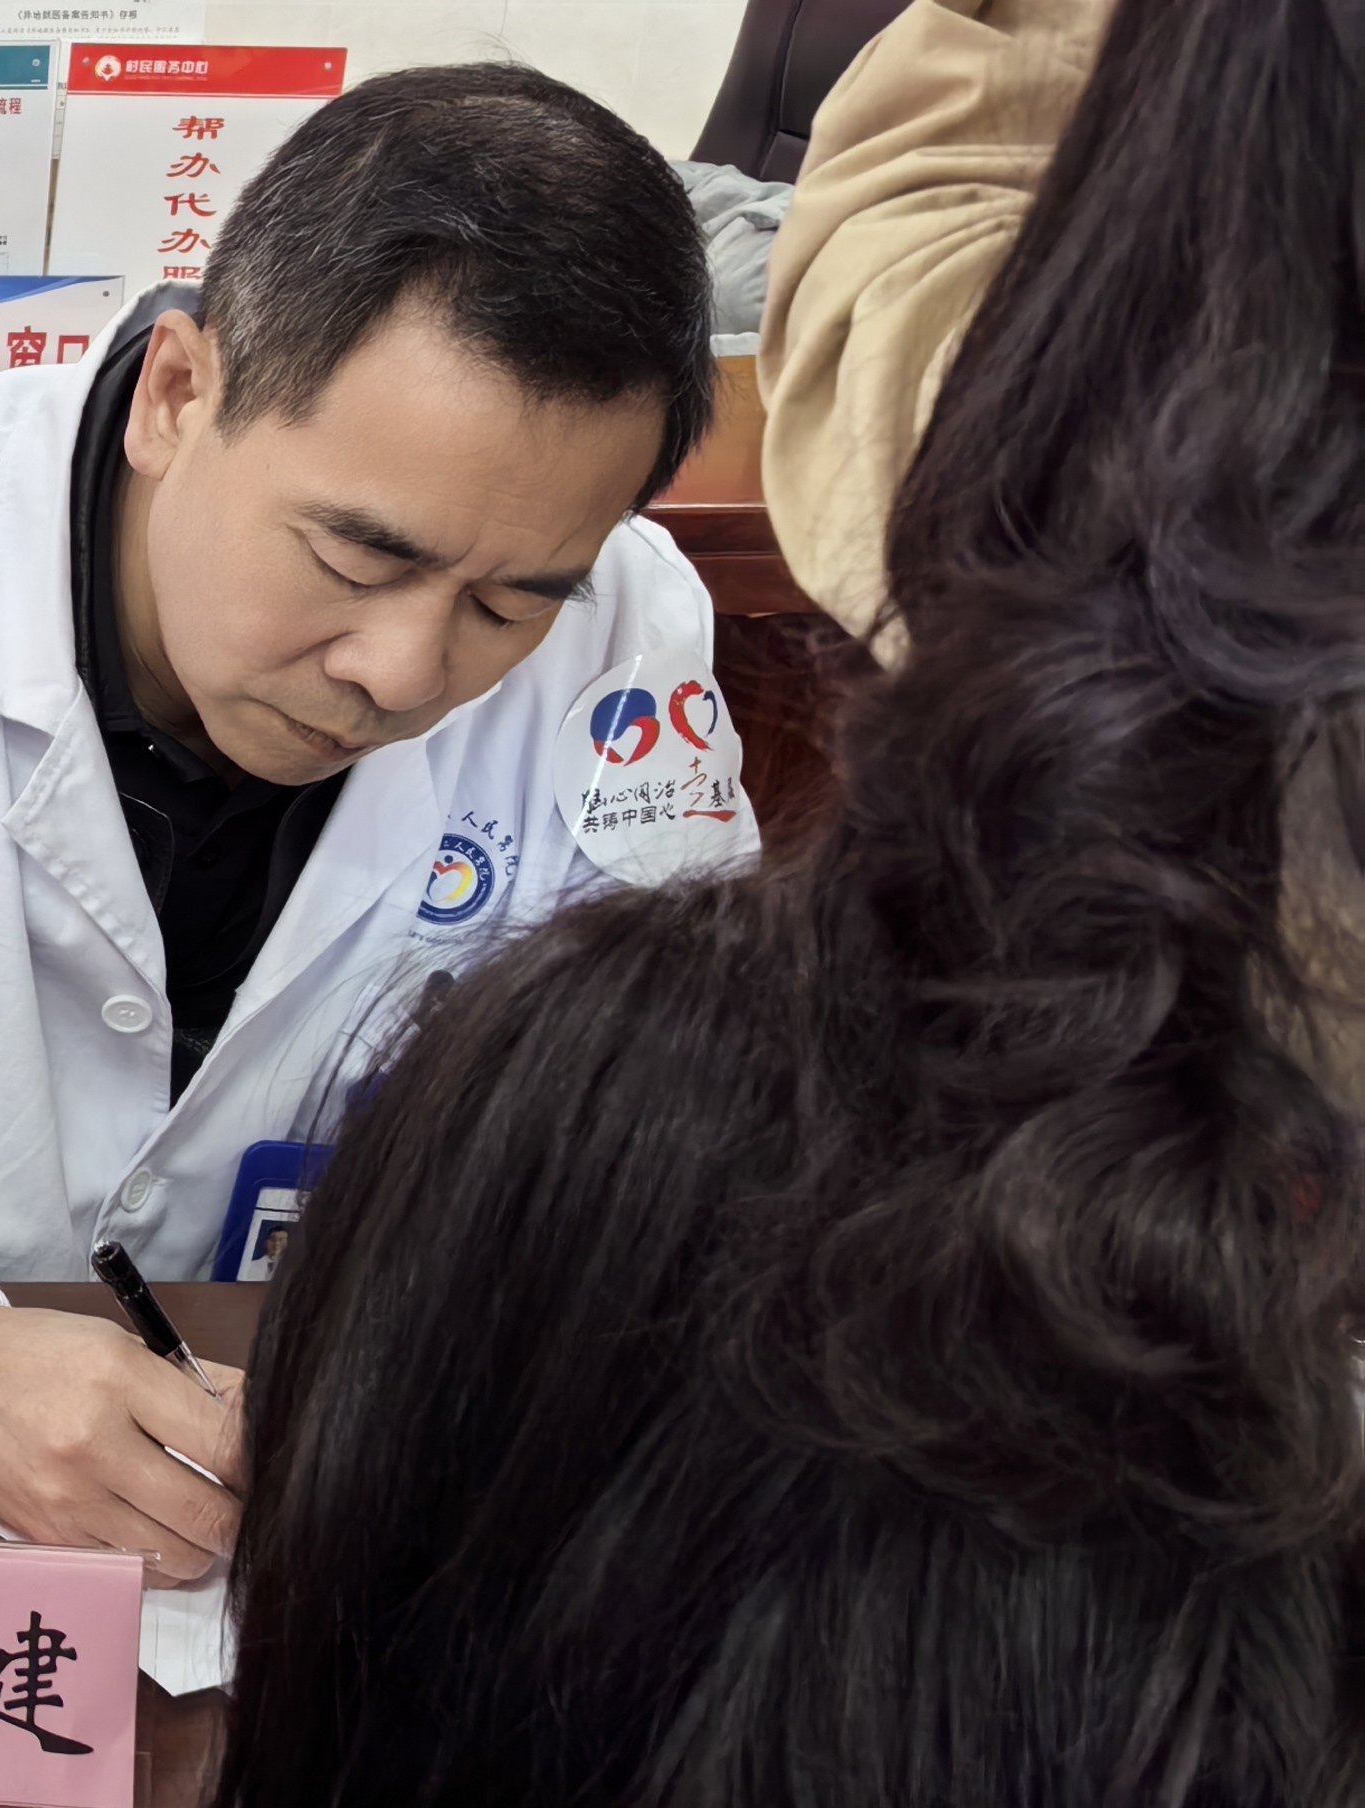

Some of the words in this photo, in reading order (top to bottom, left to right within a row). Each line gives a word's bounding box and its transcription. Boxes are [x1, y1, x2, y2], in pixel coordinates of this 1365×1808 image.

[125, 60, 209, 74] 村民服务中心
[583, 803, 677, 834] 共铸中国心
